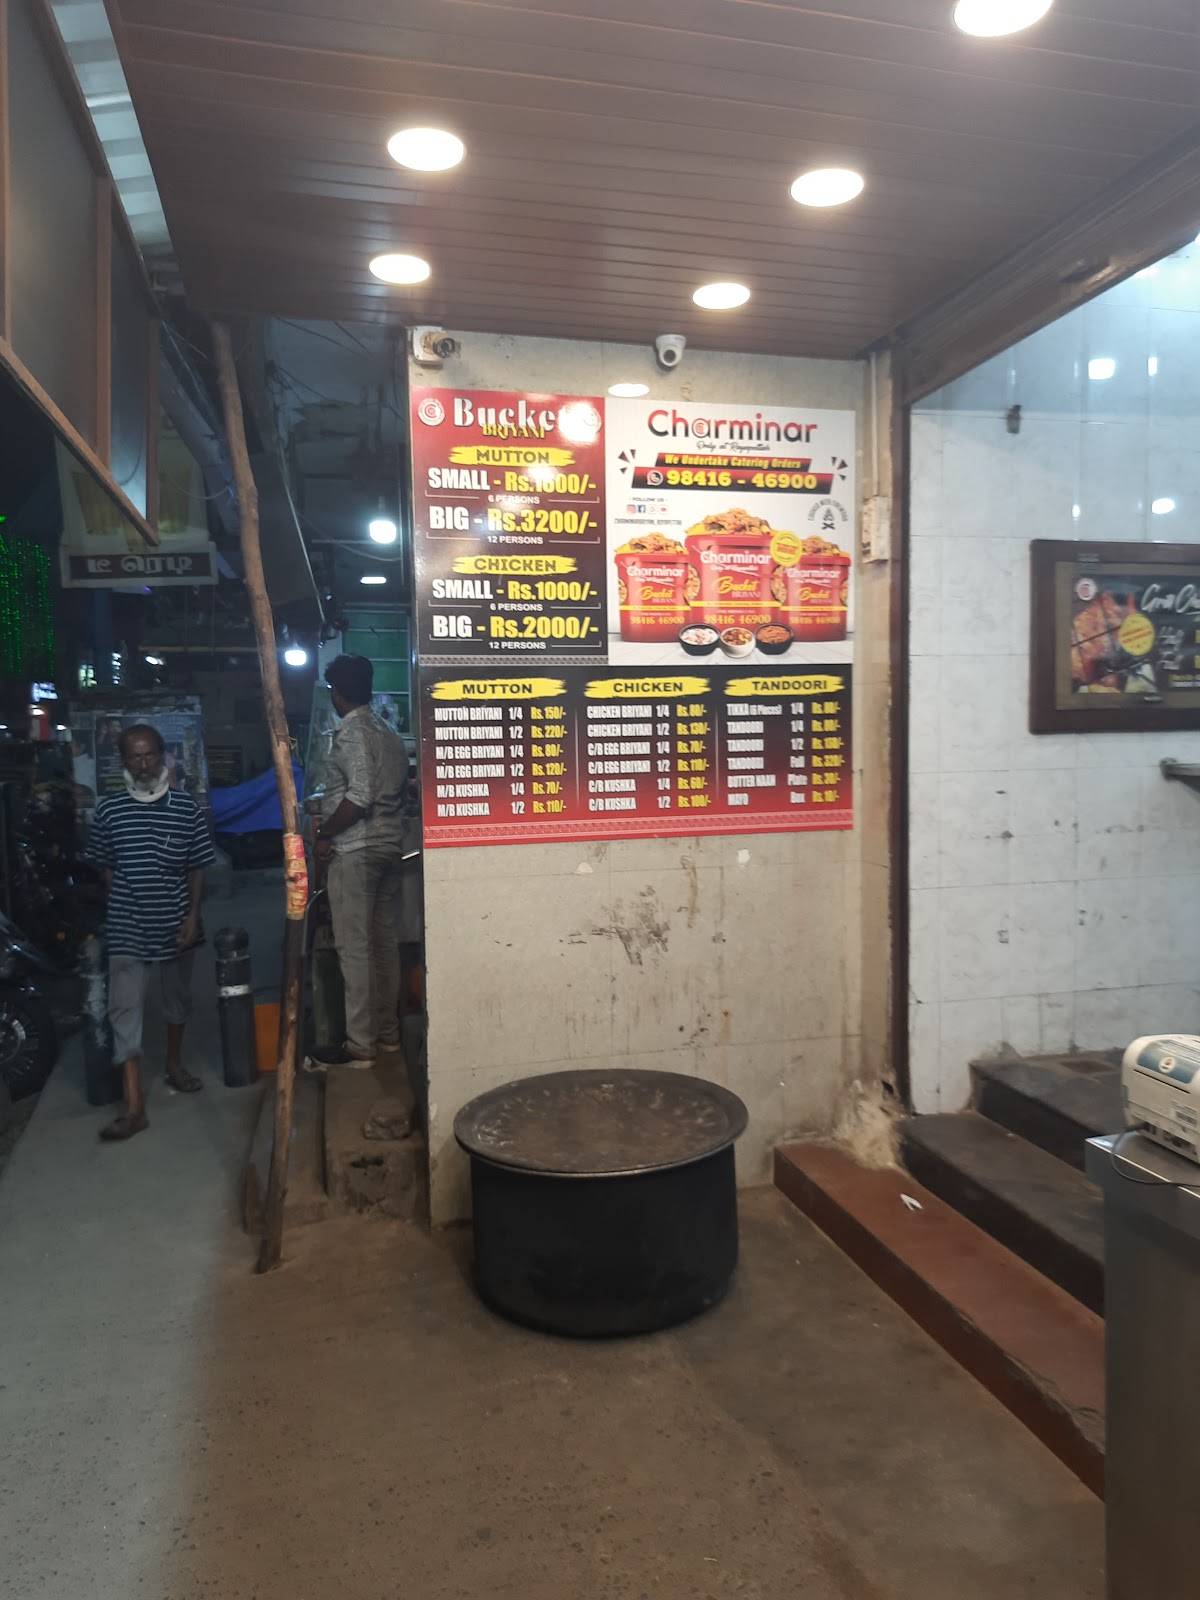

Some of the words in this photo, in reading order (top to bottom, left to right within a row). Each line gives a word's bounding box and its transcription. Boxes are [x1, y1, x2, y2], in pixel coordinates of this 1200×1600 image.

[454, 397, 566, 432] Bucke
[647, 409, 818, 443] Charminar
[476, 449, 550, 463] MUTTON
[664, 455, 679, 465] We
[681, 455, 729, 467] Undertake
[731, 457, 769, 469] Catering
[771, 459, 801, 469] Orders
[428, 467, 491, 490] SMALL
[666, 470, 731, 487] 98416
[752, 473, 817, 489] 46900
[488, 494, 494, 503] 6
[495, 495, 540, 505] PERSONS
[429, 506, 470, 530] BIG
[487, 508, 598, 534] Rs.3200/-
[499, 536, 543, 545] PERSONS
[474, 558, 557, 572] CHICKEN
[700, 550, 772, 565] Charminar
[432, 579, 494, 600] SMALL
[507, 580, 598, 601] Rs.1000/-
[490, 603, 496, 611] 6
[498, 603, 543, 612] PERSONS
[433, 615, 473, 638] BIG
[490, 616, 599, 639] Rs.2000/-
[489, 641, 500, 649] 12
[501, 641, 547, 650] PERSONS
[462, 684, 532, 694] MUTTON
[613, 682, 683, 693] CHICKEN
[752, 680, 827, 691] TANDOORI
[434, 707, 469, 721] MUTTON
[470, 706, 502, 720] BRIYANI
[509, 707, 523, 720] 1/4
[530, 707, 543, 720] Rs.
[544, 706, 566, 719] 150/-
[587, 706, 620, 719] CHICKEN
[656, 705, 669, 717] 1/4
[676, 704, 689, 717] Rs.
[435, 727, 469, 740] MUTTON
[470, 726, 503, 739] BRIYANI
[509, 726, 523, 739] 1/2
[531, 726, 544, 739] Rs.
[544, 725, 567, 738] 220/-
[587, 724, 621, 737] CHICKEN
[656, 723, 670, 736] 1/2
[677, 723, 689, 735] Rs.
[435, 746, 454, 760] M/B
[455, 746, 471, 759] EGG
[472, 745, 504, 759] BRIYANI
[510, 745, 524, 758] 1/4
[531, 745, 544, 758] Rs.
[657, 741, 670, 754] 1/4
[677, 741, 689, 753] Rs.
[436, 765, 454, 779] M/B
[455, 765, 471, 778] EGG
[472, 764, 505, 778] BRIYANI
[510, 764, 524, 777] 1/2
[532, 763, 545, 776] Rs.
[545, 763, 567, 776] 120/-
[657, 759, 671, 772] 1/2
[677, 759, 690, 771] Rs.
[437, 785, 455, 798] M/B
[456, 784, 489, 797] KUSHKA
[511, 783, 524, 796] 1/4
[532, 782, 545, 794] Rs.
[546, 781, 563, 794] 70/-
[604, 779, 636, 792] KUSHKA
[657, 778, 671, 790] 1/4
[677, 777, 690, 790] Rs.
[437, 804, 455, 817] M/B
[456, 803, 490, 816] KUSHKA
[511, 801, 525, 814] 1/2
[533, 801, 546, 813] Rs.
[547, 800, 566, 813] 110/-
[605, 797, 636, 810] KUSHKA
[657, 796, 671, 809] 1/2
[678, 796, 690, 808] Rs.
